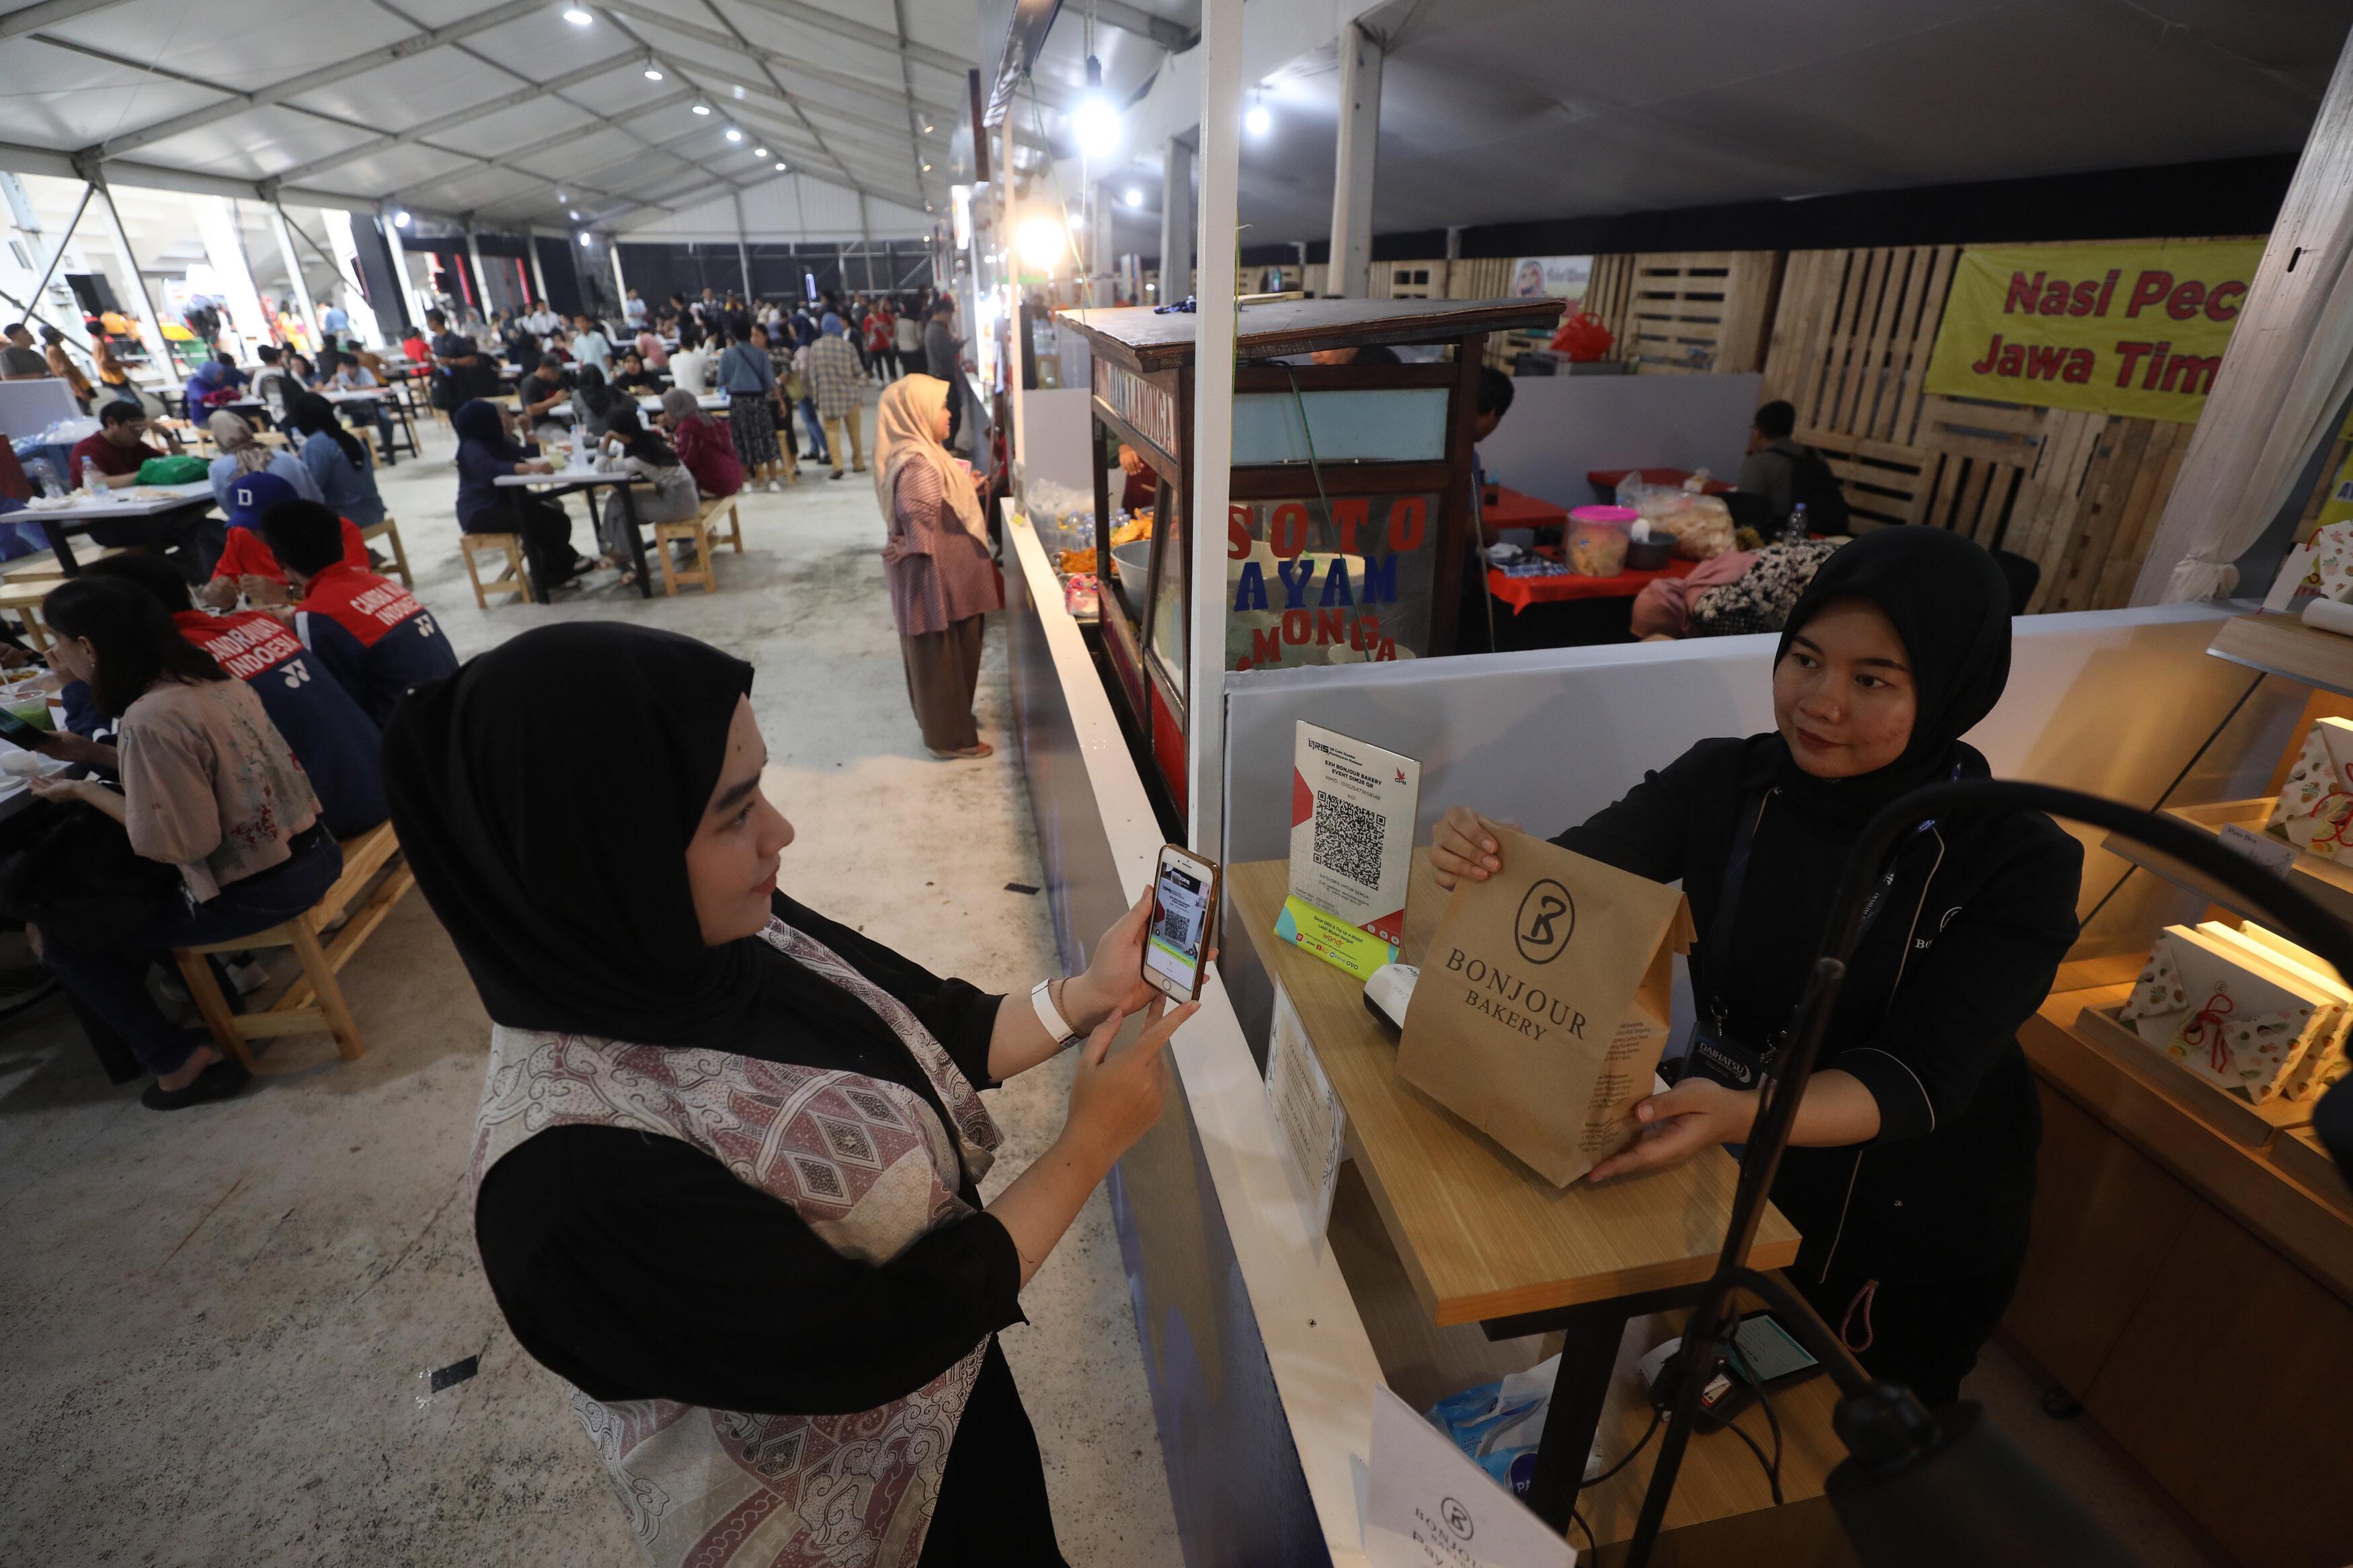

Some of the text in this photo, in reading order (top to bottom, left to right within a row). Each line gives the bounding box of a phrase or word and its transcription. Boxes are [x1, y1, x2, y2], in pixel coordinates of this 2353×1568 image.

[2004, 269, 2247, 322] Nasi Pec
[1972, 333, 2222, 396] Jawa Tim
[237, 488, 252, 505] D
[1228, 497, 1426, 560] SOTO
[1234, 554, 1398, 612] AYAM
[1308, 739, 1329, 753] QRIS
[1326, 775, 1338, 784] NMID
[1332, 769, 1349, 779] EVENT
[1337, 764, 1360, 778] BONJOUR
[1361, 774, 1382, 785] BAKERY
[1323, 932, 1344, 947] wondr
[1346, 960, 1359, 970] OVO
[1445, 947, 1586, 1040] BONJOUR
[1464, 989, 1548, 1041] BAKERY
[1700, 1042, 1744, 1073] DAIHATSU
[1415, 1508, 1476, 1568] BONJO
